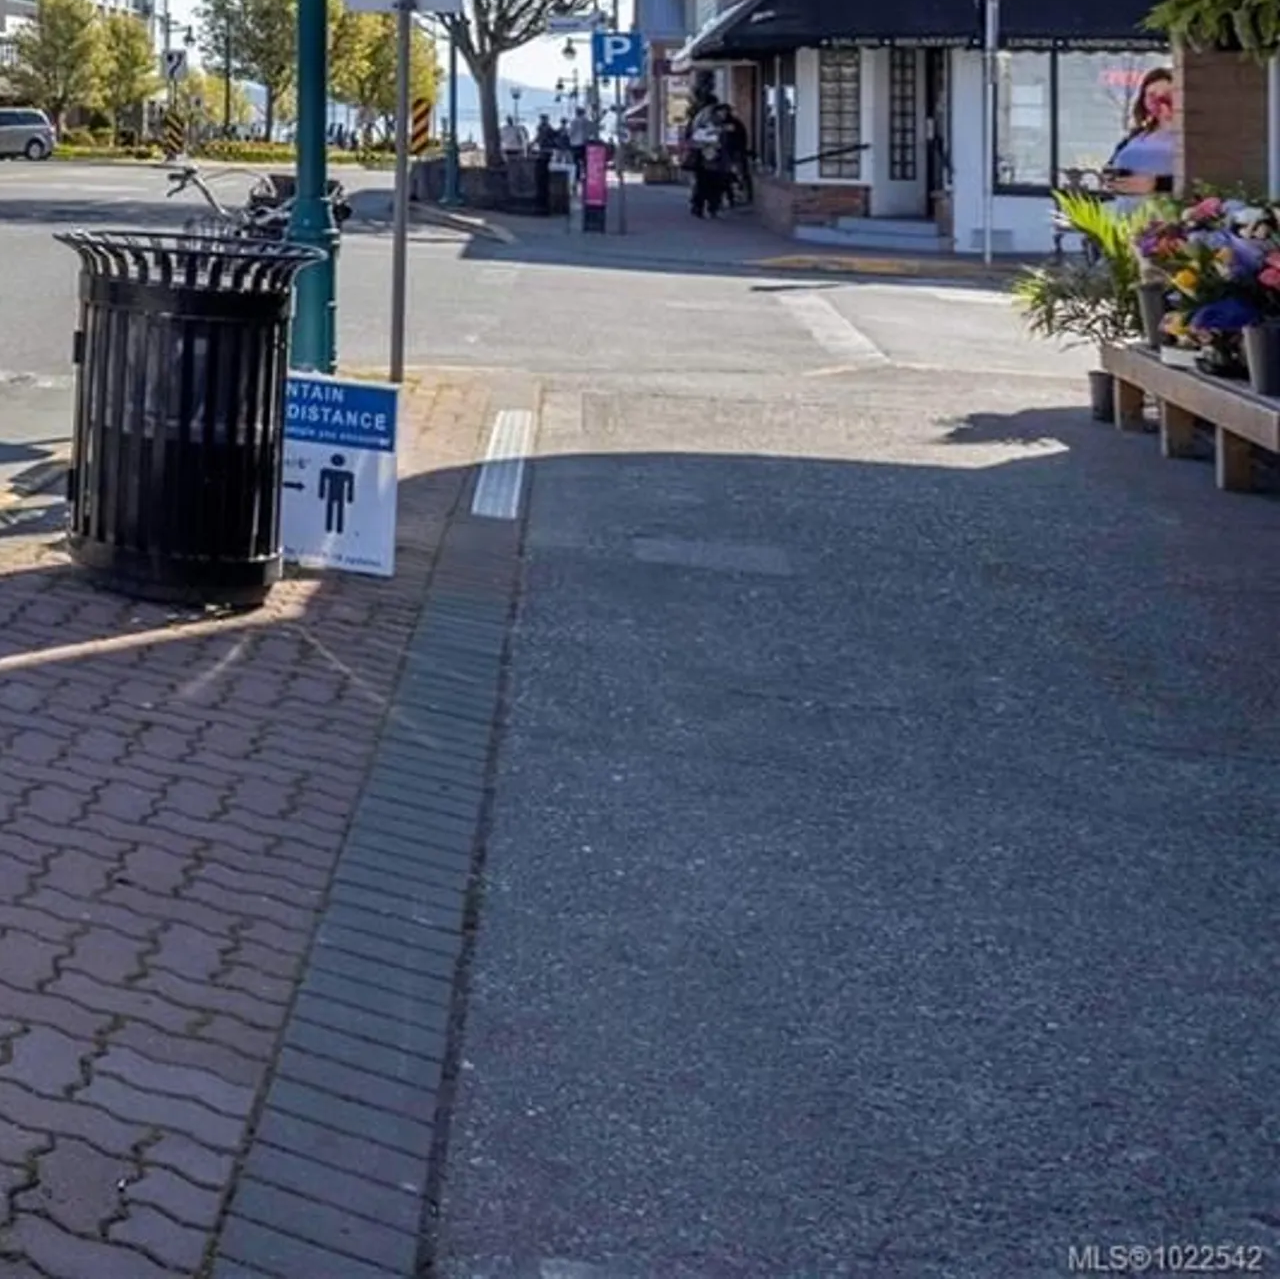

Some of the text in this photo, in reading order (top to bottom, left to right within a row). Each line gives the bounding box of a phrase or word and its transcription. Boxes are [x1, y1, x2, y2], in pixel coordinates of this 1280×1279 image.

[604, 36, 632, 64] P
[286, 381, 344, 403] NTAIN
[287, 402, 387, 432] DISTANCE
